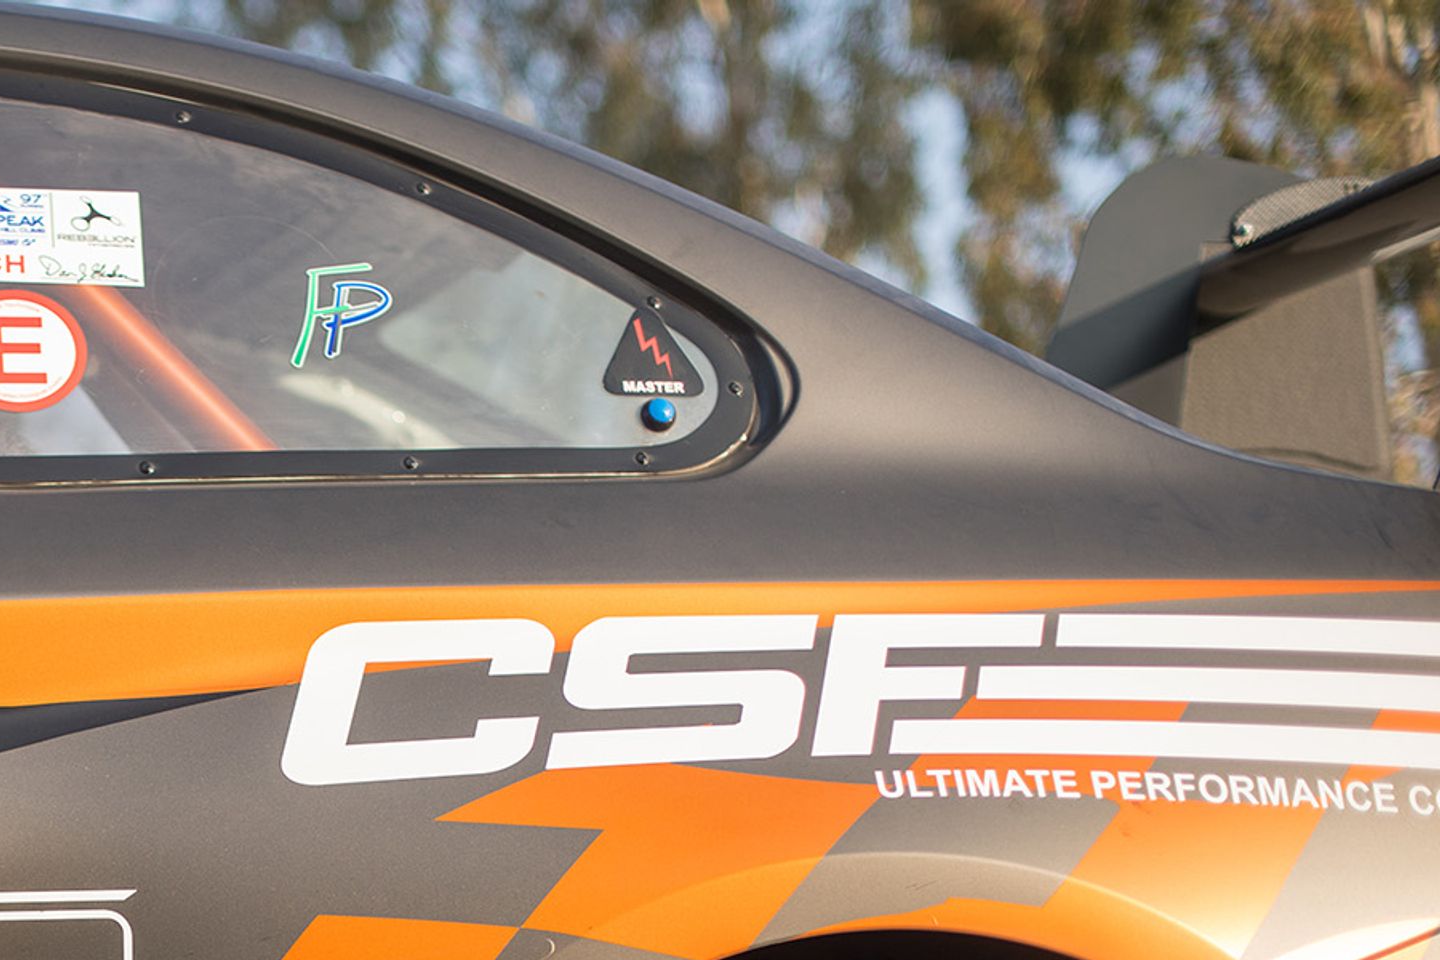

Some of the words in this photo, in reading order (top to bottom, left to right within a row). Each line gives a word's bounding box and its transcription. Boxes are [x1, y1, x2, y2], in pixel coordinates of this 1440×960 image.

[622, 380, 685, 394] MASTER
[280, 613, 1044, 786] CSF
[874, 768, 1081, 800] ULTIMATE
[1090, 770, 1399, 814] PERFORMANCE
[1408, 785, 1440, 816] C
